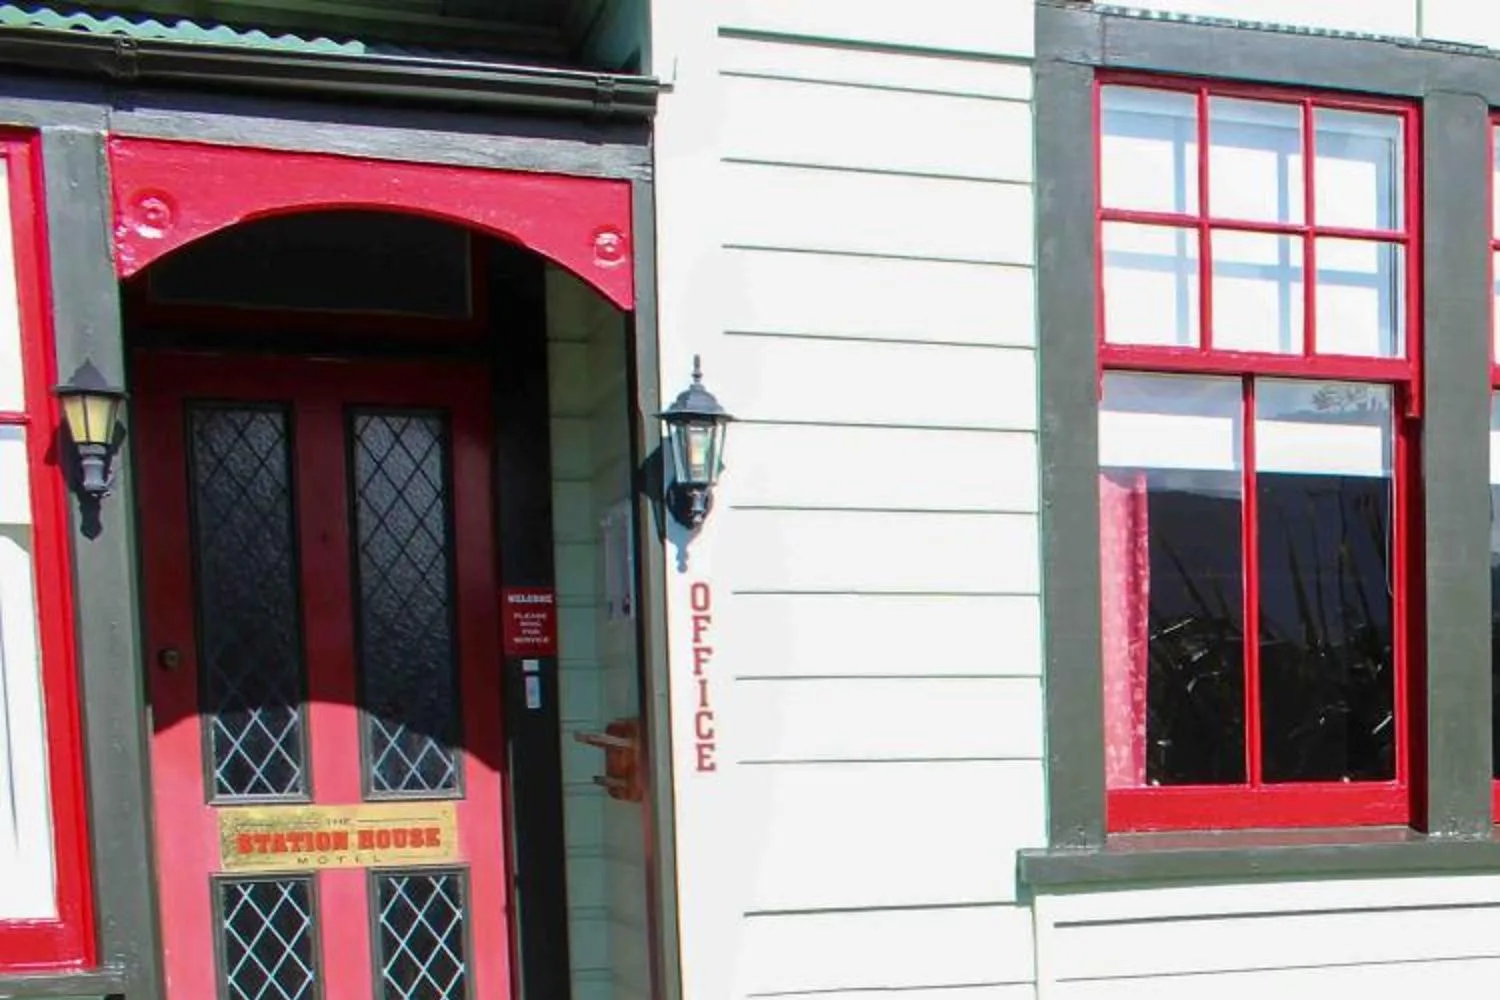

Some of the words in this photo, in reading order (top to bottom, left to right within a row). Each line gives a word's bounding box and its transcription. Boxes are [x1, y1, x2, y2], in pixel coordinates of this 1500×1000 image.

[507, 593, 553, 604] WELCOME
[690, 581, 716, 772] OFFICE
[326, 817, 351, 826] THE
[236, 830, 348, 854] STATION
[357, 827, 441, 850] HOUSE
[296, 855, 382, 865] MOTEL
